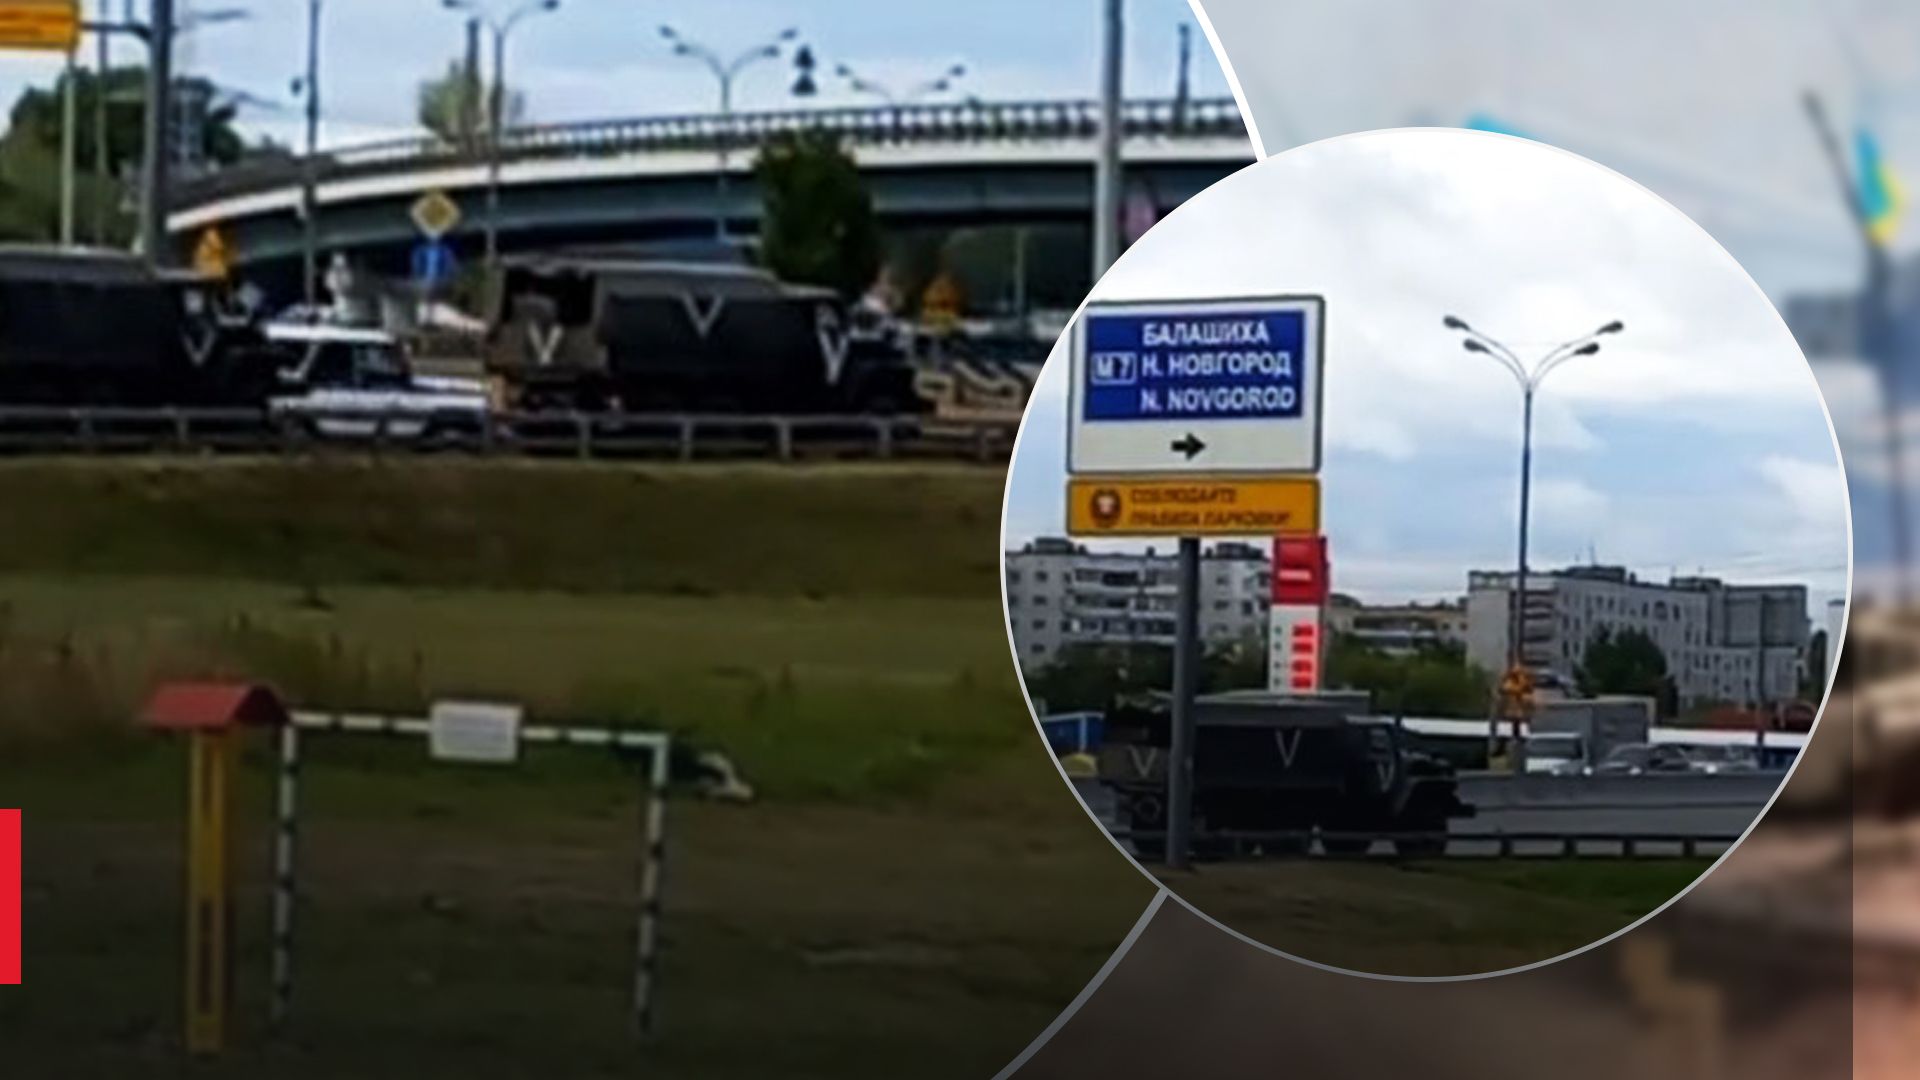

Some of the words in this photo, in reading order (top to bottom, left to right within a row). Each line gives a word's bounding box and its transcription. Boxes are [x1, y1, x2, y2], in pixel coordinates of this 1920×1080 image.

[680, 293, 724, 338] V
[1142, 320, 1270, 346] БАЛАШИХА
[526, 321, 563, 366] V
[817, 324, 851, 386] V
[1141, 353, 1162, 377] Н.
[1168, 350, 1292, 378] НОВГОРОД
[1140, 389, 1162, 412] N.
[1168, 385, 1296, 412] NOVGOROD
[1129, 744, 1158, 778] V
[1275, 728, 1301, 768] V
